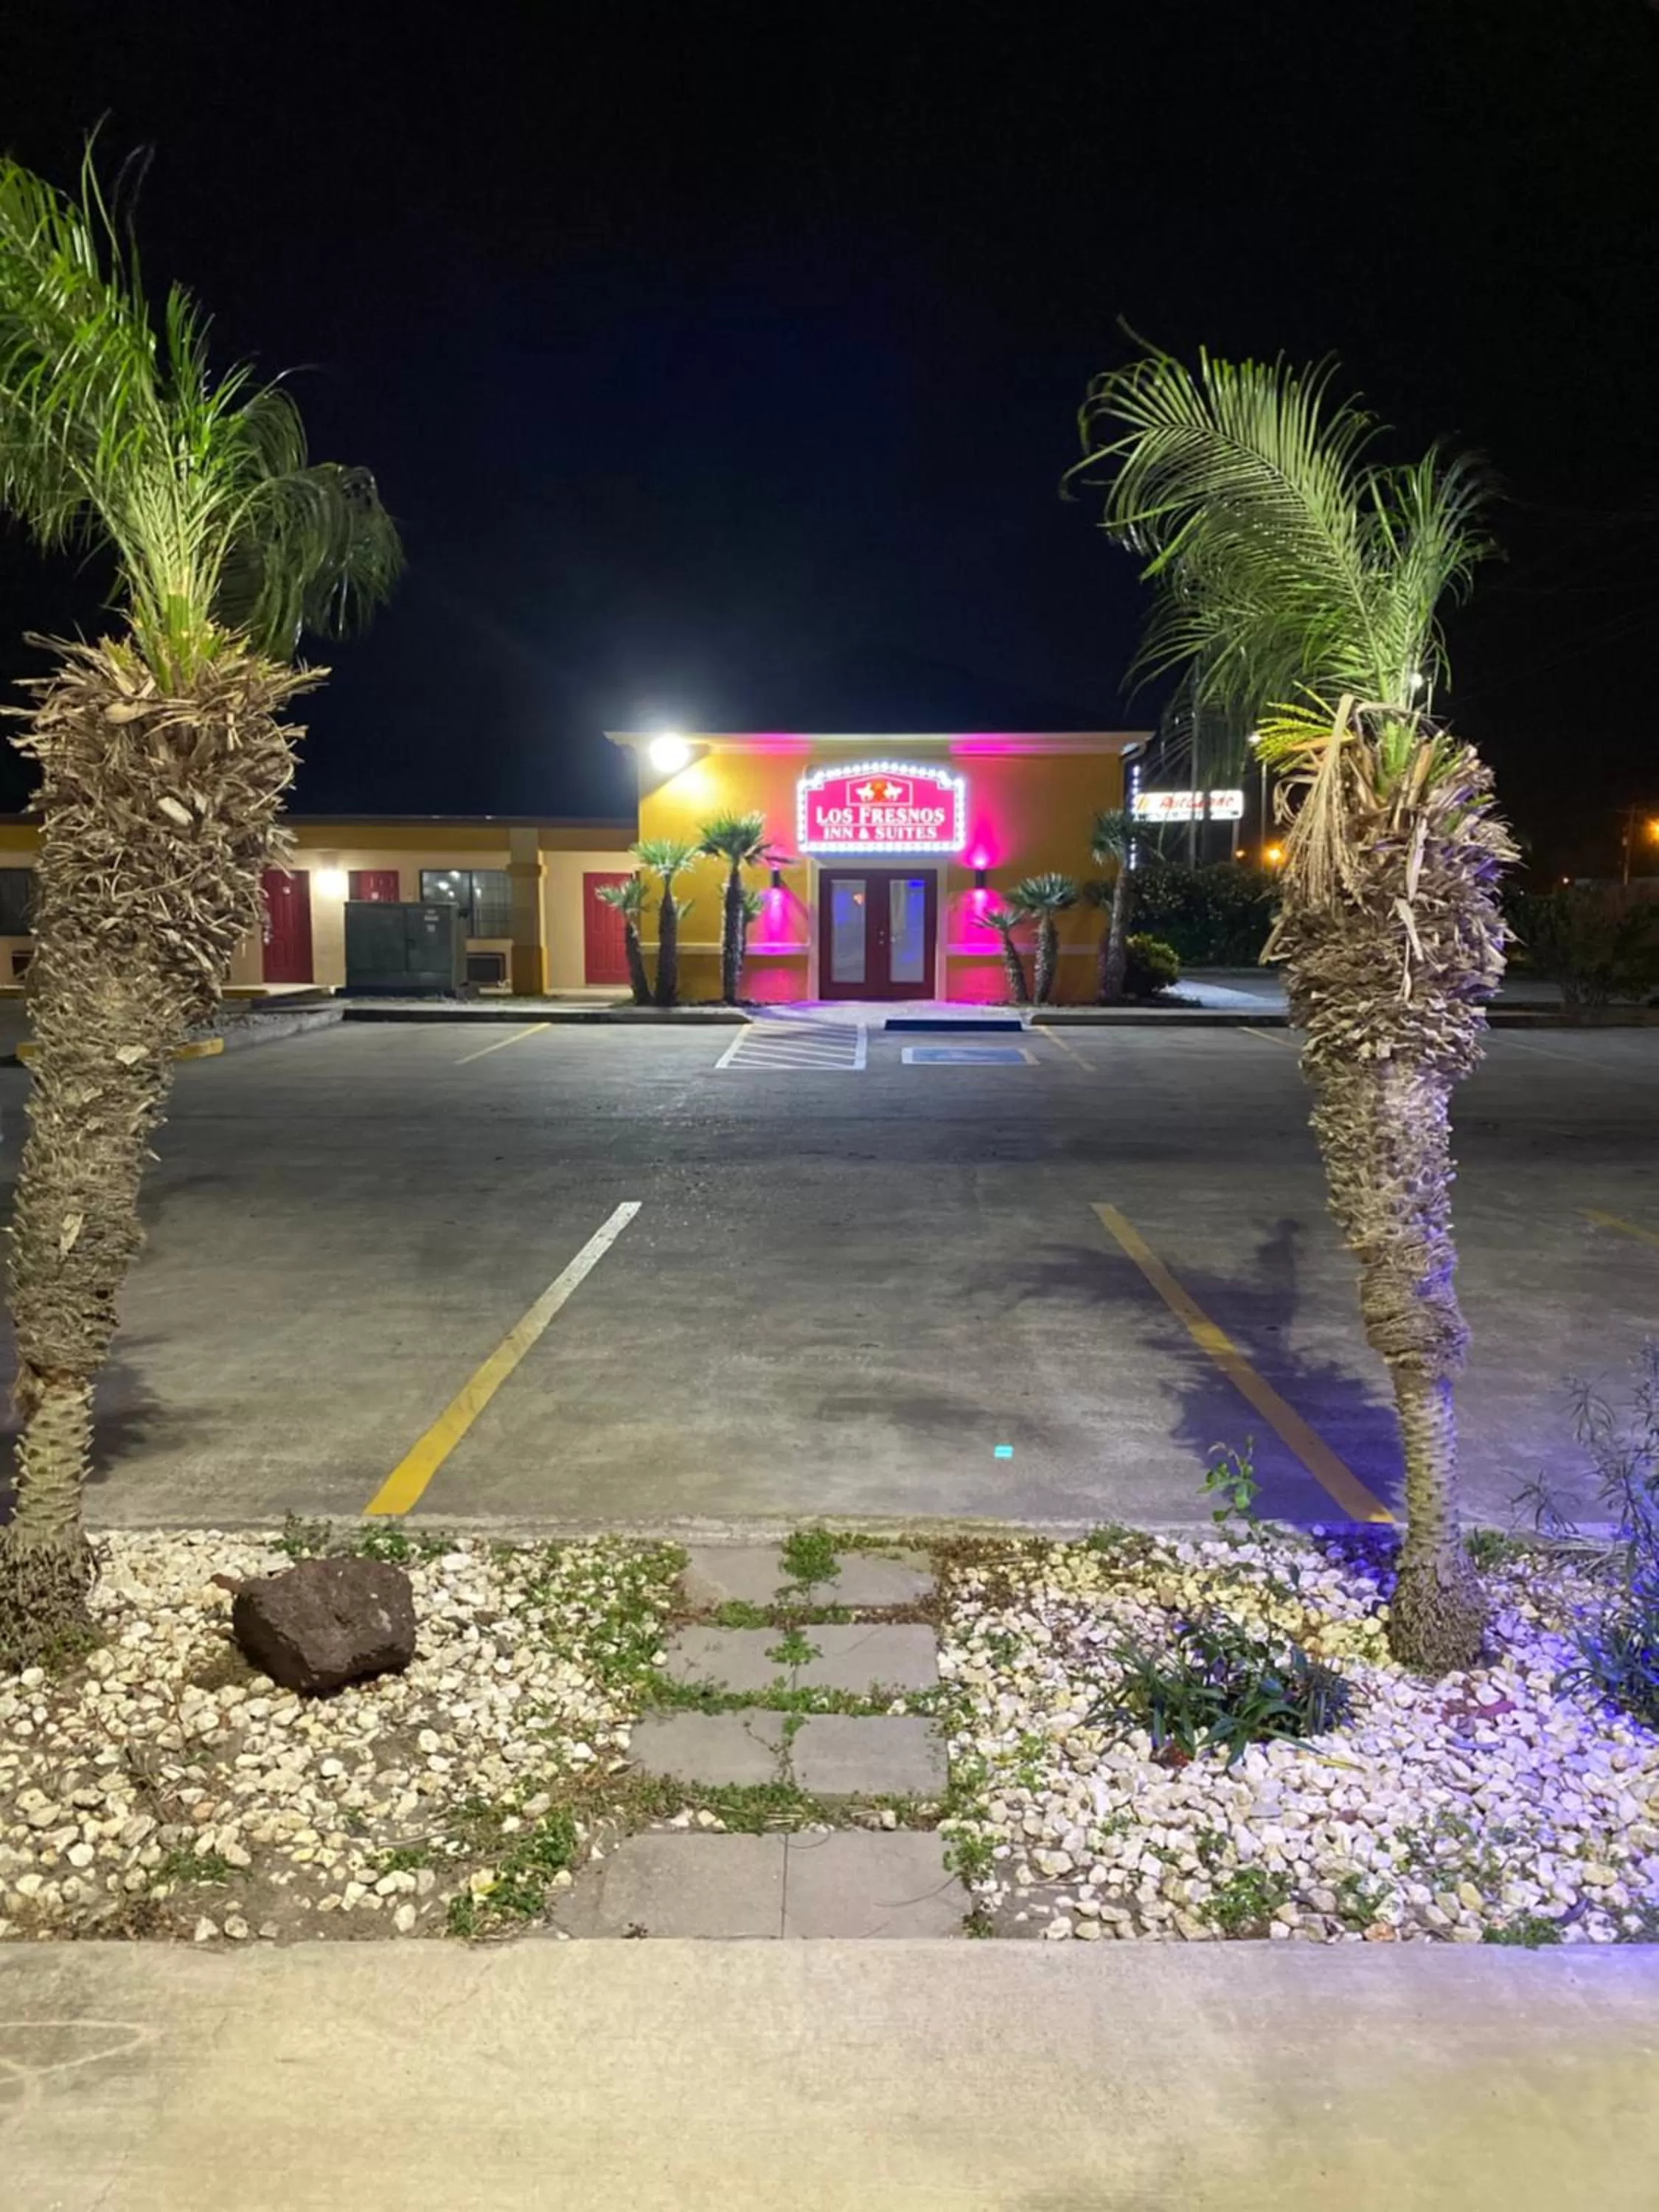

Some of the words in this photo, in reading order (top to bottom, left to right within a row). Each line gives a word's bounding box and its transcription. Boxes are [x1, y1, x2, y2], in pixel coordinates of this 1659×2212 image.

[816, 805, 852, 824] LOS
[859, 804, 945, 824] FRESNOS
[824, 826, 853, 840] INN
[859, 826, 870, 840] &
[874, 826, 937, 840] SUITES
